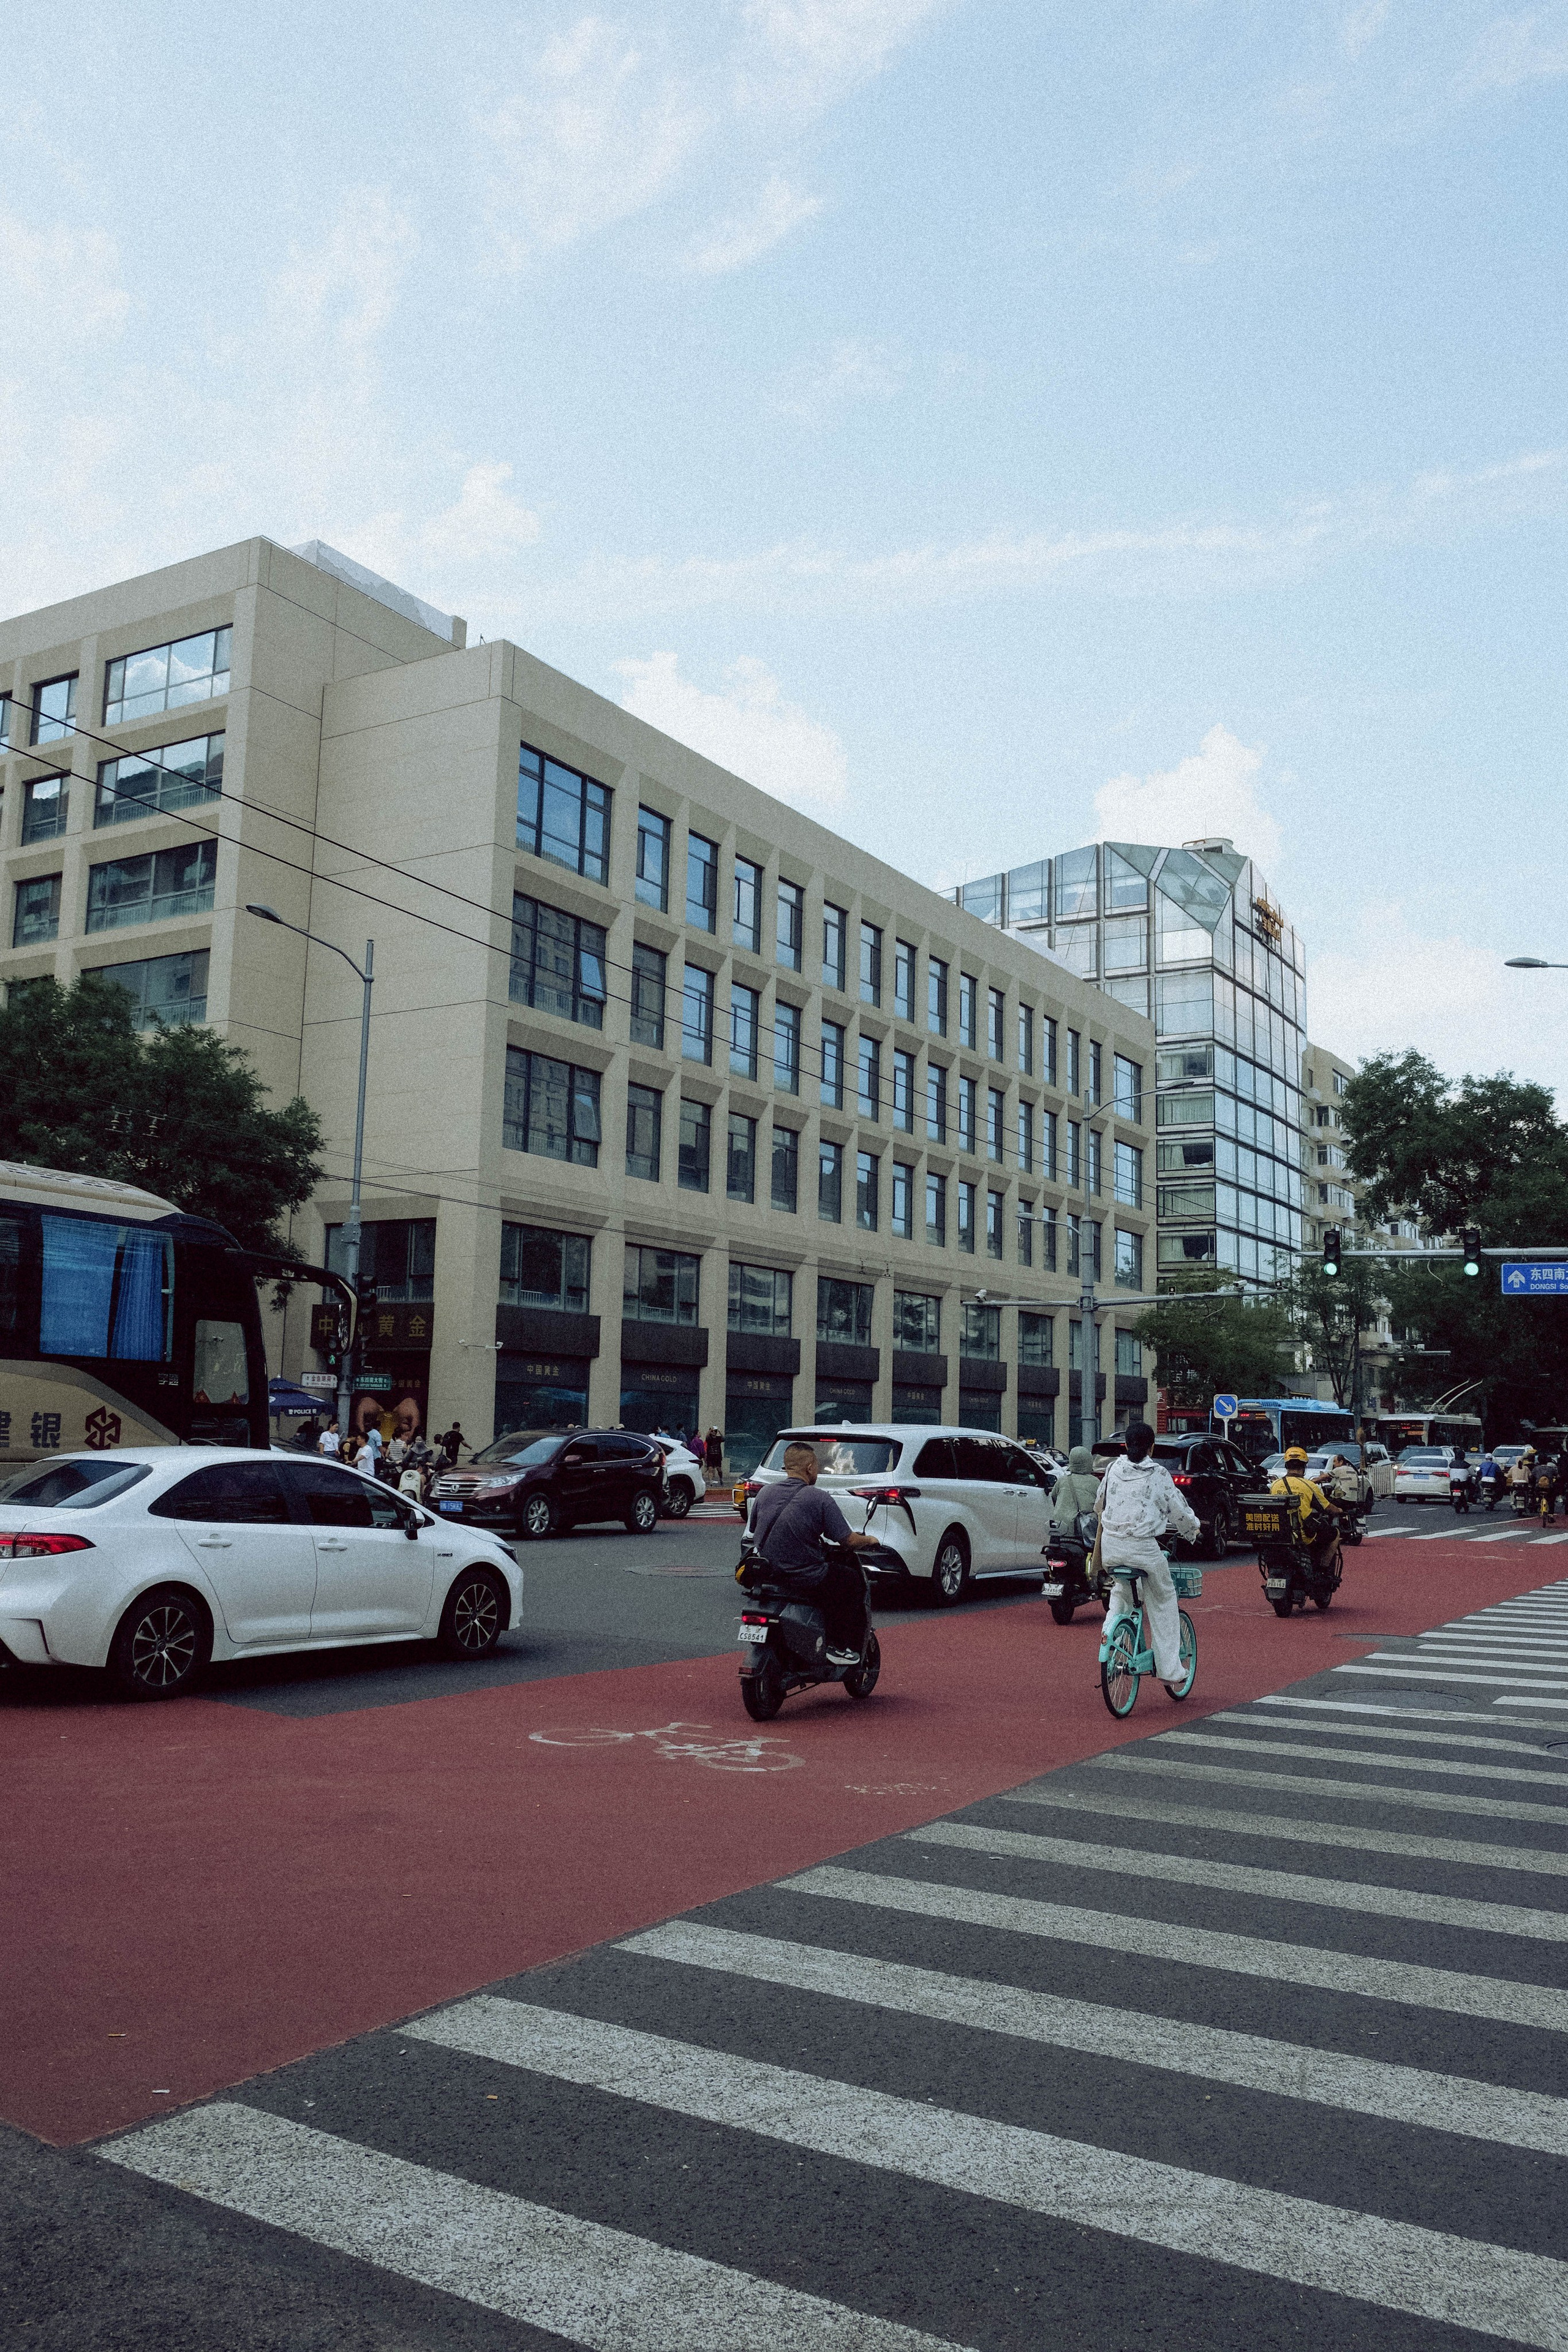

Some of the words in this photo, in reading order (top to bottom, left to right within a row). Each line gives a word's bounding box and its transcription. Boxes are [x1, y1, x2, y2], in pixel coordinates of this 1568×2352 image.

[1531, 1268, 1568, 1280] 东四南
[318, 1314, 426, 1338] 中黄金
[527, 1364, 560, 1376] 中国黄金
[1245, 1513, 1280, 1522] 美团配送
[1246, 1523, 1280, 1531] 准时好用
